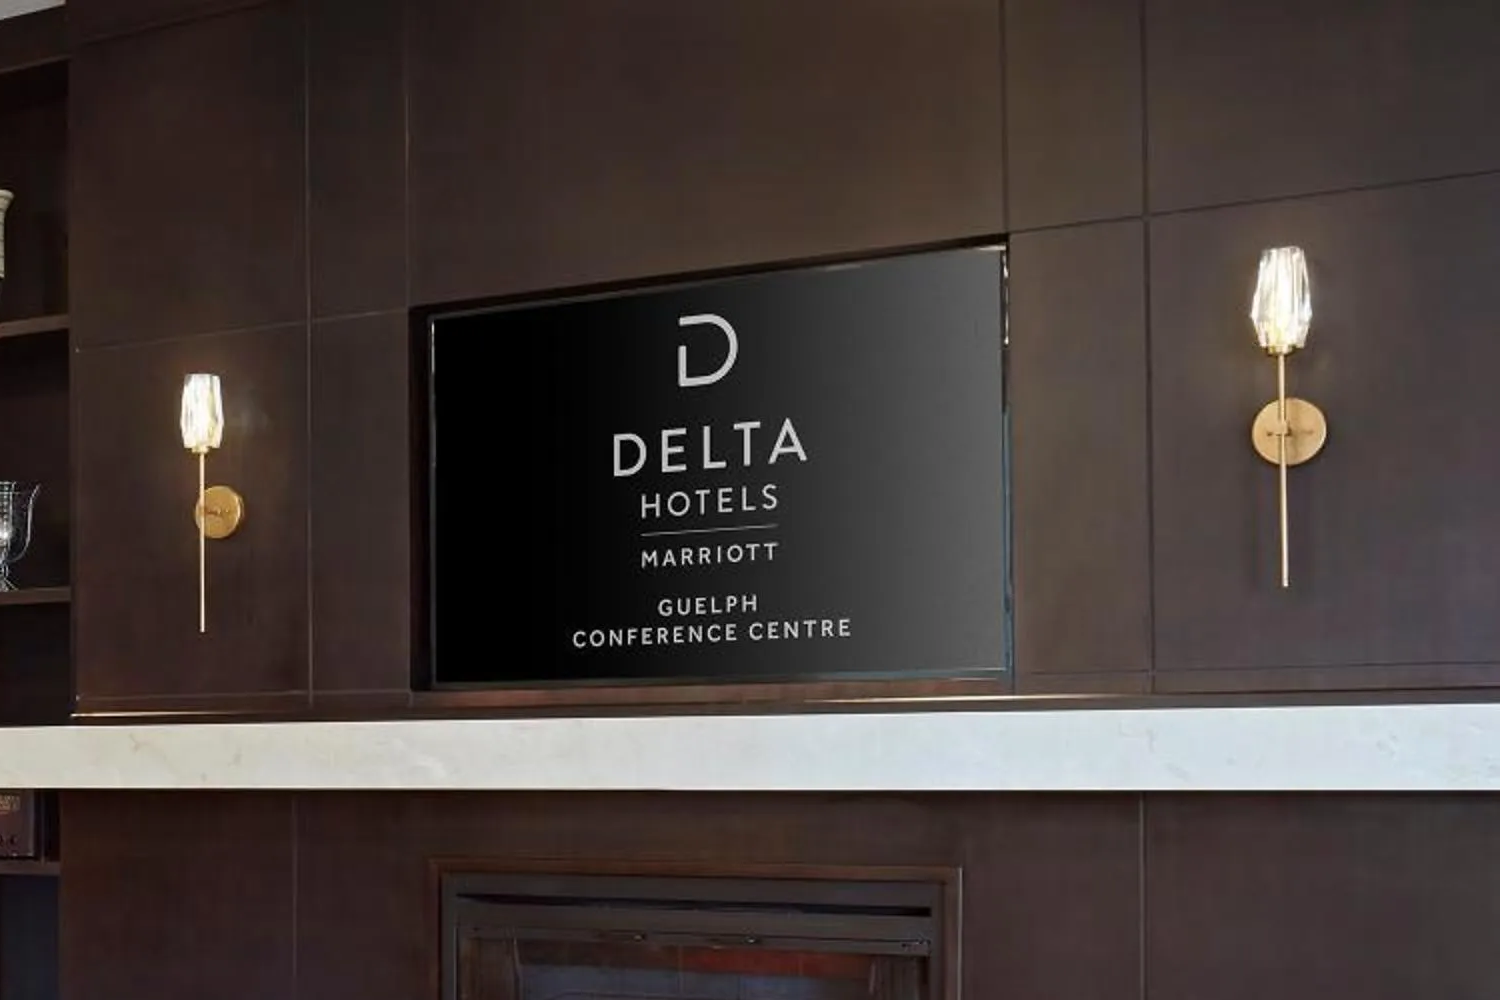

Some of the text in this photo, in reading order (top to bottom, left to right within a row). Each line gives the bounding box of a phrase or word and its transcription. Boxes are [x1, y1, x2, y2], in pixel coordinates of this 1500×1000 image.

[677, 313, 739, 388] D
[613, 417, 808, 478] DELTA
[641, 483, 779, 519] HOTELS
[641, 542, 780, 569] MARRIOTT
[658, 594, 758, 617] GUELPH
[572, 618, 852, 649] CONFERENCE CENTRE
